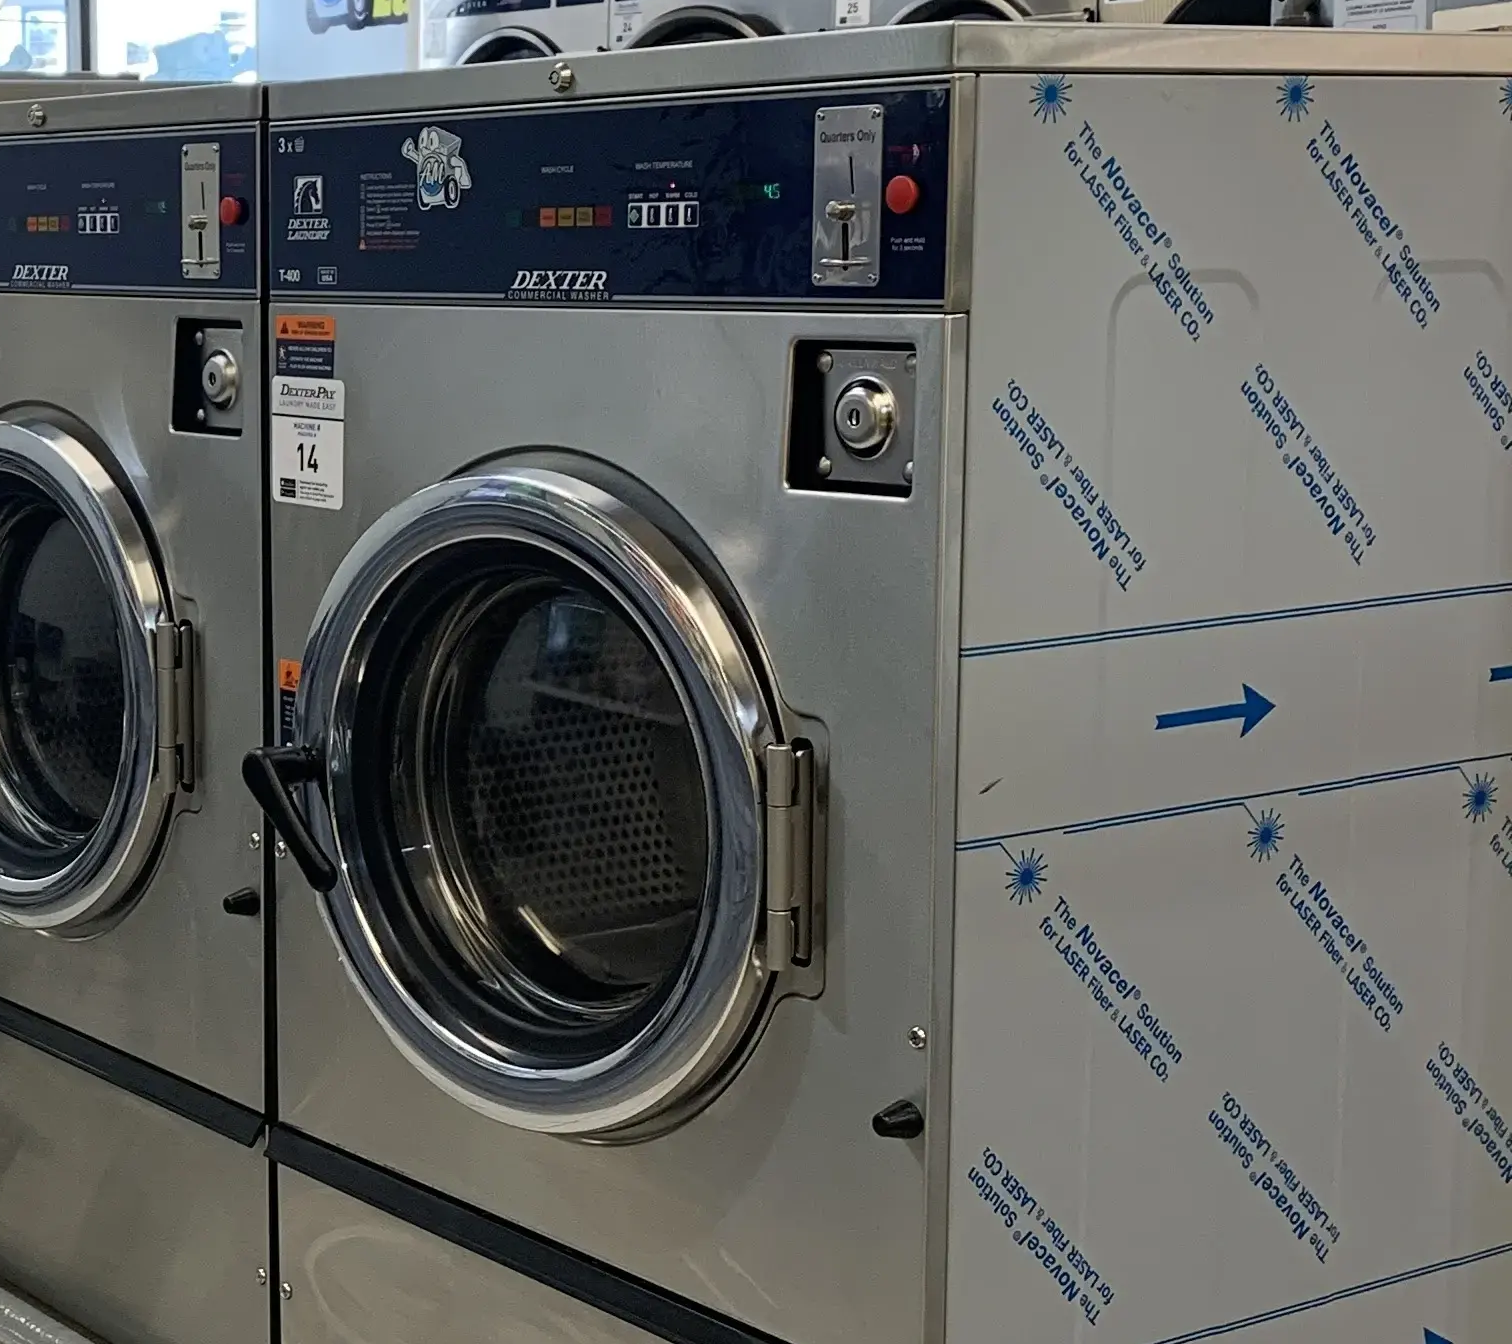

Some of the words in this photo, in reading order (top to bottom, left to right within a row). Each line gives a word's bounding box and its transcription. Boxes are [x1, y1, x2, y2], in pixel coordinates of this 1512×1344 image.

[847, 2, 859, 15] 25
[278, 137, 286, 153] 3
[819, 131, 855, 144] Quarters
[856, 129, 877, 144] Only
[1064, 140, 1083, 167] for
[1080, 164, 1116, 219] LASER
[1114, 213, 1144, 256] Fiber
[1145, 262, 1182, 316] LASER
[1079, 120, 1102, 160] The
[1168, 253, 1214, 324] Solution
[1306, 138, 1324, 164] for
[1320, 160, 1354, 212] LASER
[1351, 208, 1378, 247] Fiber
[1381, 253, 1412, 303] LASER
[1320, 119, 1341, 157] The
[1399, 244, 1440, 313] Solution
[12, 264, 69, 280] DEXTER
[278, 268, 300, 283] T-400
[511, 270, 608, 290] DEXTER
[507, 290, 568, 300] COMMERCIAL
[570, 290, 609, 301] WASHER
[992, 397, 1044, 470] Solution
[1026, 406, 1065, 460] LASER
[1240, 380, 1287, 450] Solution
[1272, 390, 1305, 440] LASER
[297, 442, 319, 473] 14
[1308, 445, 1336, 484] Fiber
[1069, 466, 1100, 506] Fiber
[1332, 478, 1365, 527] LASER
[1096, 500, 1130, 551] LASER
[1361, 523, 1376, 546] for
[1126, 546, 1147, 572] for
[1344, 531, 1364, 566] The
[1109, 556, 1132, 592] The
[1276, 873, 1293, 896] for
[1290, 891, 1321, 936] LASER
[1317, 930, 1344, 966] Fiber
[1346, 967, 1376, 1011] LASER
[1289, 853, 1309, 887] The
[1362, 956, 1403, 1015] Solution
[1039, 916, 1058, 941] for
[1055, 935, 1090, 983] LASER
[1087, 975, 1114, 1012] Fiber
[1118, 1015, 1152, 1062] LASER
[1054, 895, 1076, 930] The
[1137, 1003, 1182, 1064] Solution
[968, 1167, 1017, 1228] Solution
[1001, 1169, 1037, 1216] LASER
[1041, 1217, 1070, 1252] Fiber
[1067, 1244, 1100, 1289] LASER
[1080, 1294, 1100, 1326] The
[1096, 1282, 1114, 1306] for
